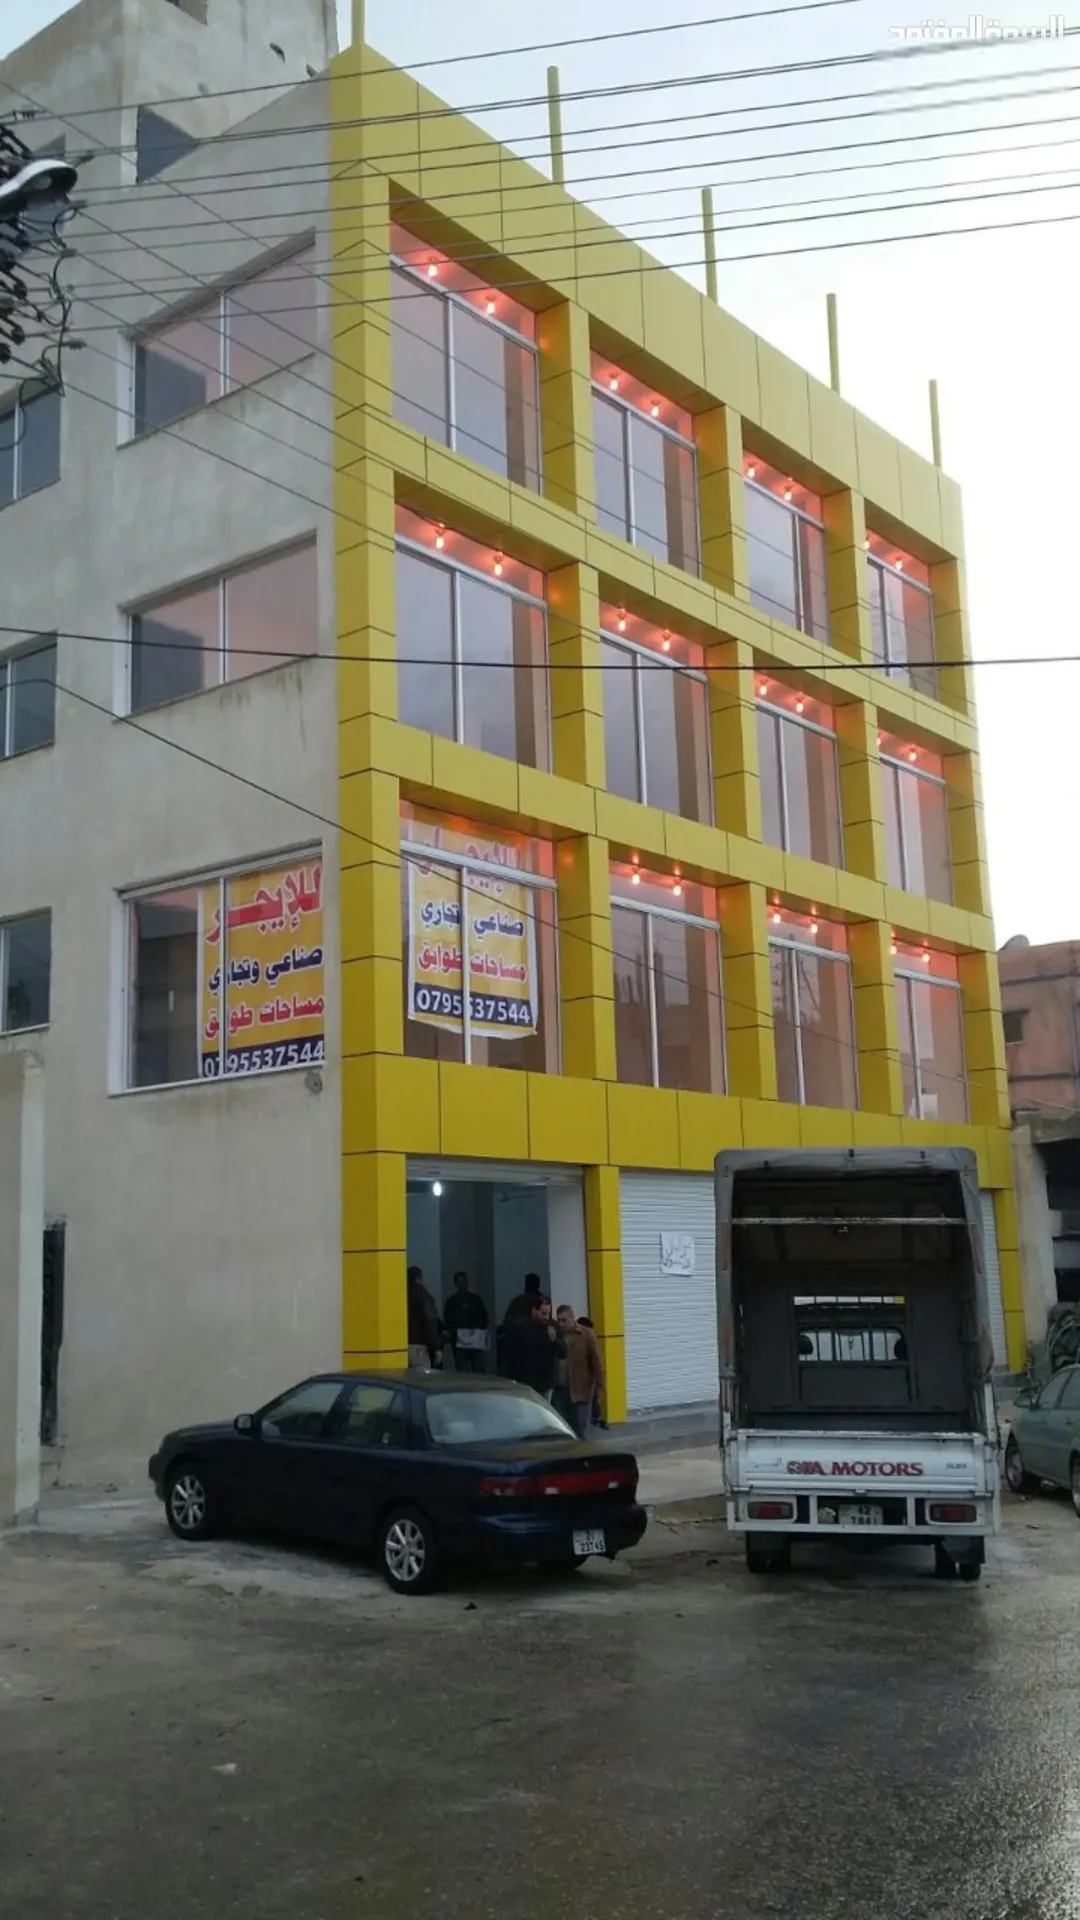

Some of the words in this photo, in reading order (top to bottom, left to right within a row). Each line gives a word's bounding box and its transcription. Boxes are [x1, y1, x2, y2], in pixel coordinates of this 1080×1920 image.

[205, 866, 322, 943] للإيجر
[421, 900, 463, 929] تجاري
[474, 911, 524, 939] صناعي
[265, 947, 323, 986] صناعي
[469, 952, 527, 983] مساحات
[205, 1004, 253, 1038] طوق
[259, 995, 324, 1023] مساحات
[831, 1461, 924, 1476] MOTORS
